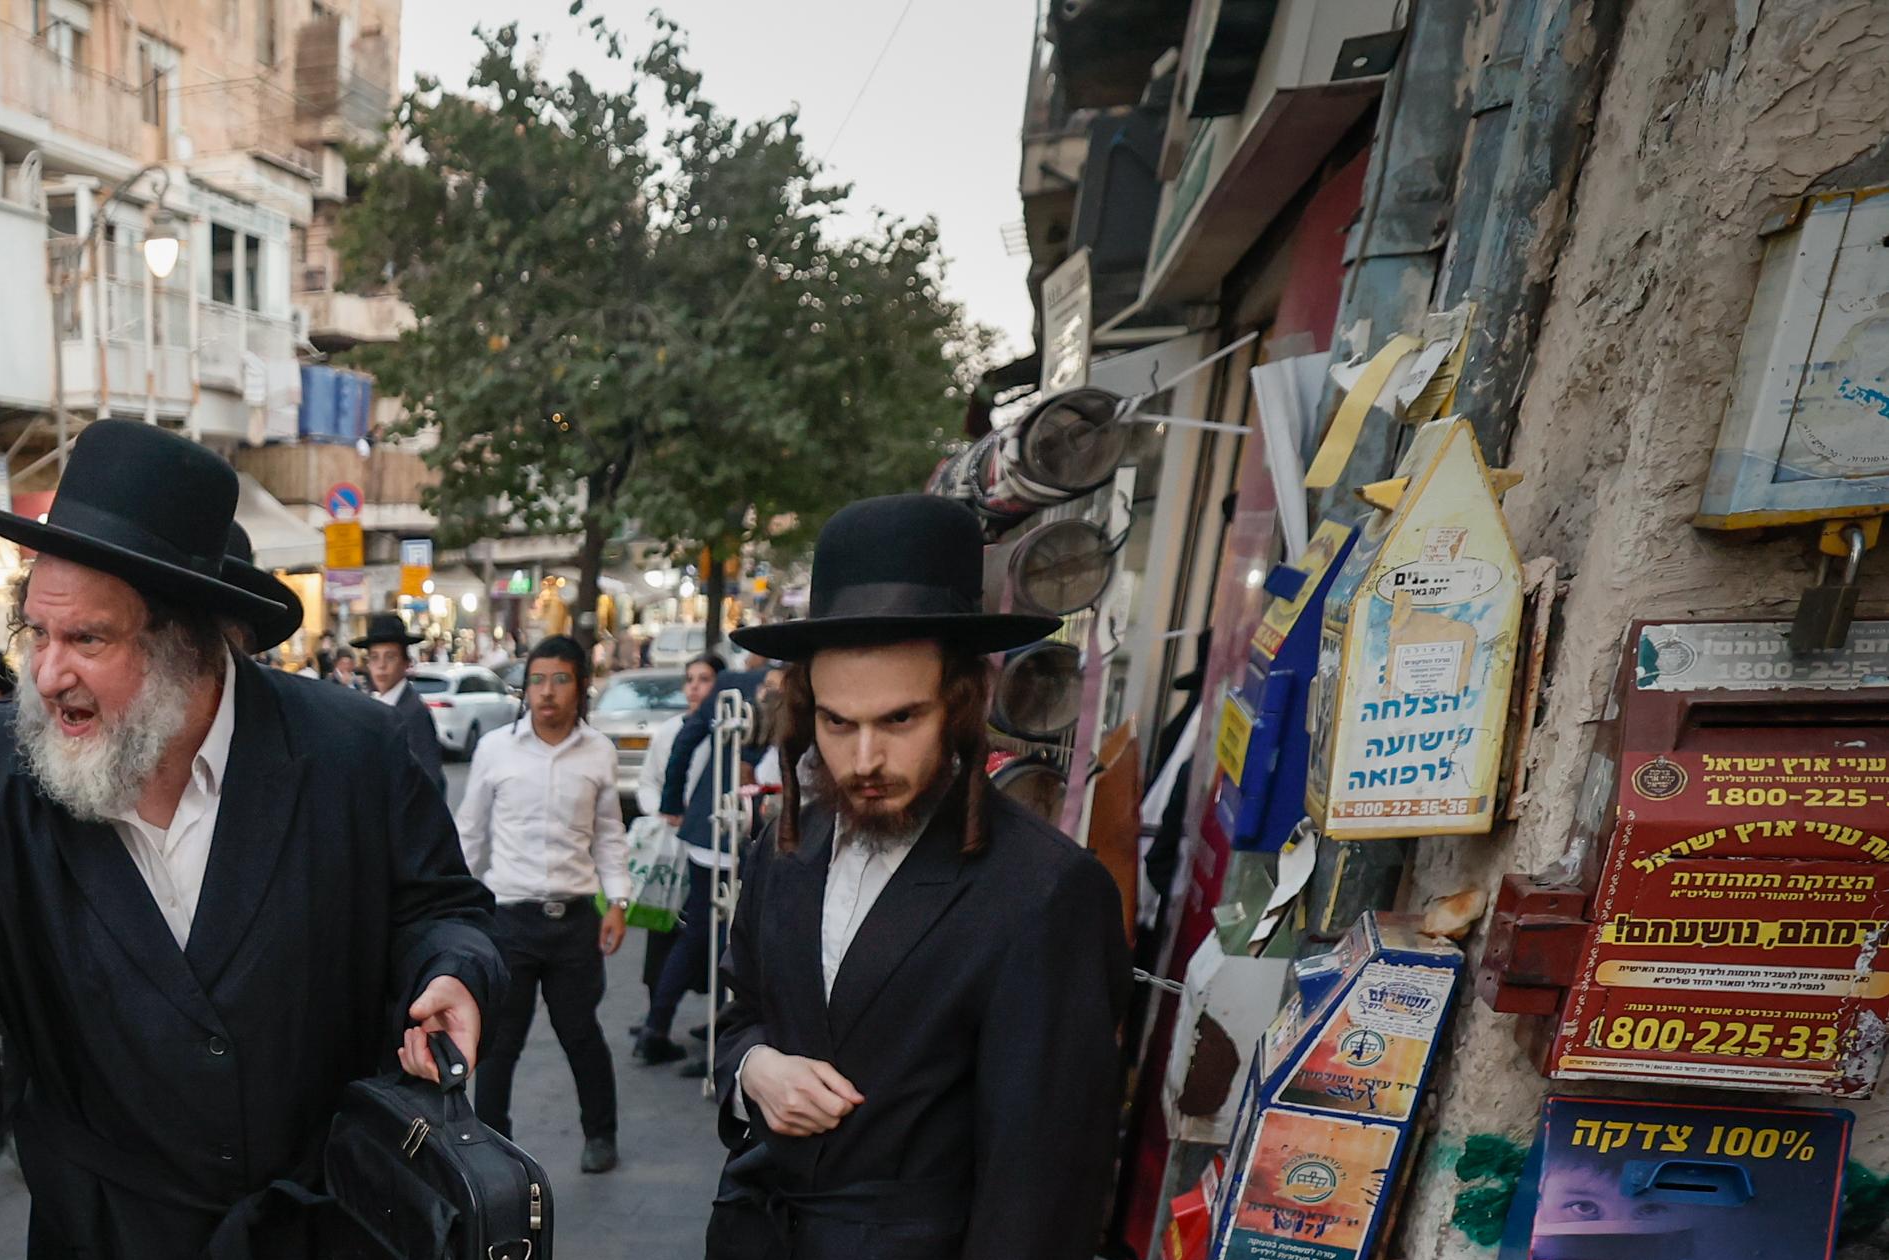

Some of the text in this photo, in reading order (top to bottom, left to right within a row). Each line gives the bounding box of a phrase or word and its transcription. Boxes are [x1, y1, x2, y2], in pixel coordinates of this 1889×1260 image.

[1701, 754, 1777, 773] ישראל
[1781, 757, 1832, 775] ארץ
[1348, 757, 1456, 791] לרפואה
[1339, 800, 1468, 817] 1-800-22-36-36
[1734, 819, 1797, 843] ארץ
[1804, 820, 1863, 846] עניי
[1631, 828, 1726, 874] ישראל
[1670, 871, 1876, 891] הצדקה המהודרת
[1727, 890, 1757, 900] הדור
[1760, 890, 1805, 901] ומאורי
[1807, 891, 1842, 902] גדולי
[1843, 891, 1867, 903] של
[1614, 914, 1760, 946] נושעתם!
[1623, 1002, 1839, 1021] לתרומות בכרטיס אשראי חייגו כעת:
[1571, 1118, 1815, 1161] 100% צדקה
